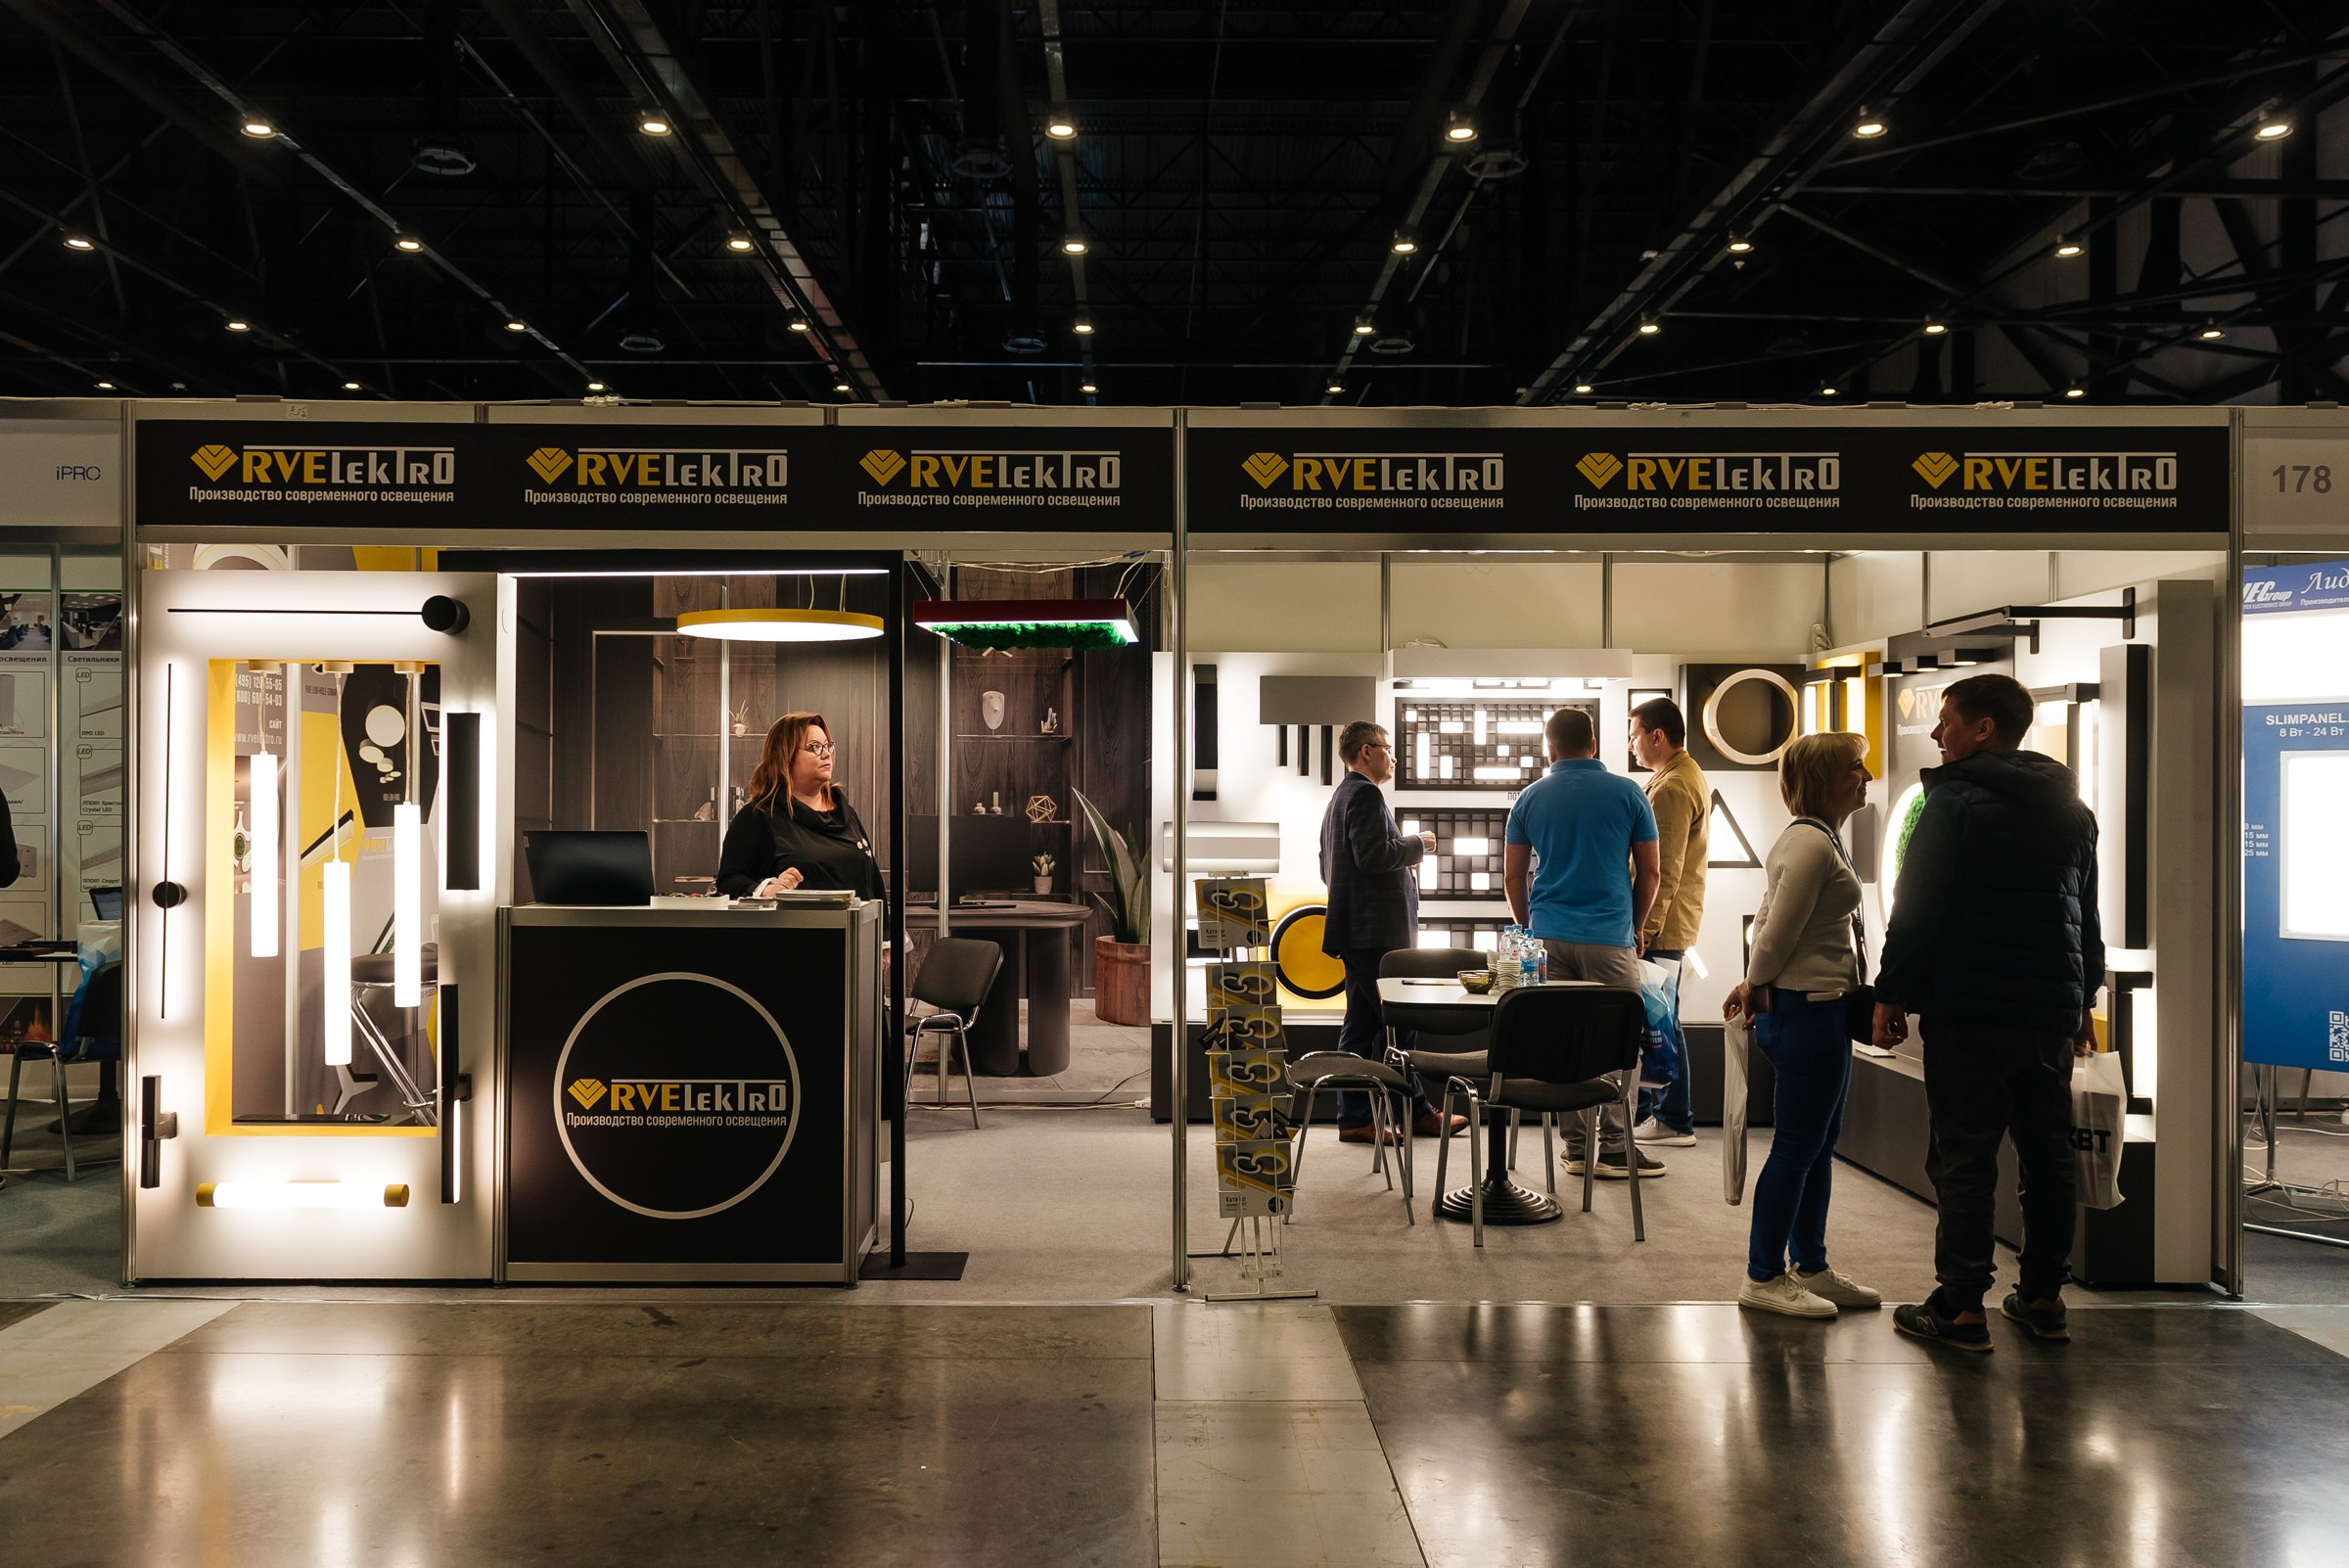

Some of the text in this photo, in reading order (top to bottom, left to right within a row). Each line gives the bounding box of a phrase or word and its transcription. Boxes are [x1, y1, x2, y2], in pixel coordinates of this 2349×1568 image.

[57, 466, 101, 481] iPRO
[2272, 465, 2331, 493] 178
[190, 486, 453, 503] Производство современного освещения
[526, 489, 787, 505] Производство современного освещения
[858, 491, 1120, 507] Производство современного освещения
[1241, 494, 1503, 510] Производство современного освещения
[1575, 495, 1839, 510] Производство современного освещения
[1911, 494, 2177, 510] Производство современного освещения
[236, 689, 251, 705] 800)
[2280, 728, 2286, 737] 8
[2313, 727, 2327, 736] 24
[567, 1112, 786, 1128] Производство современного освещения
